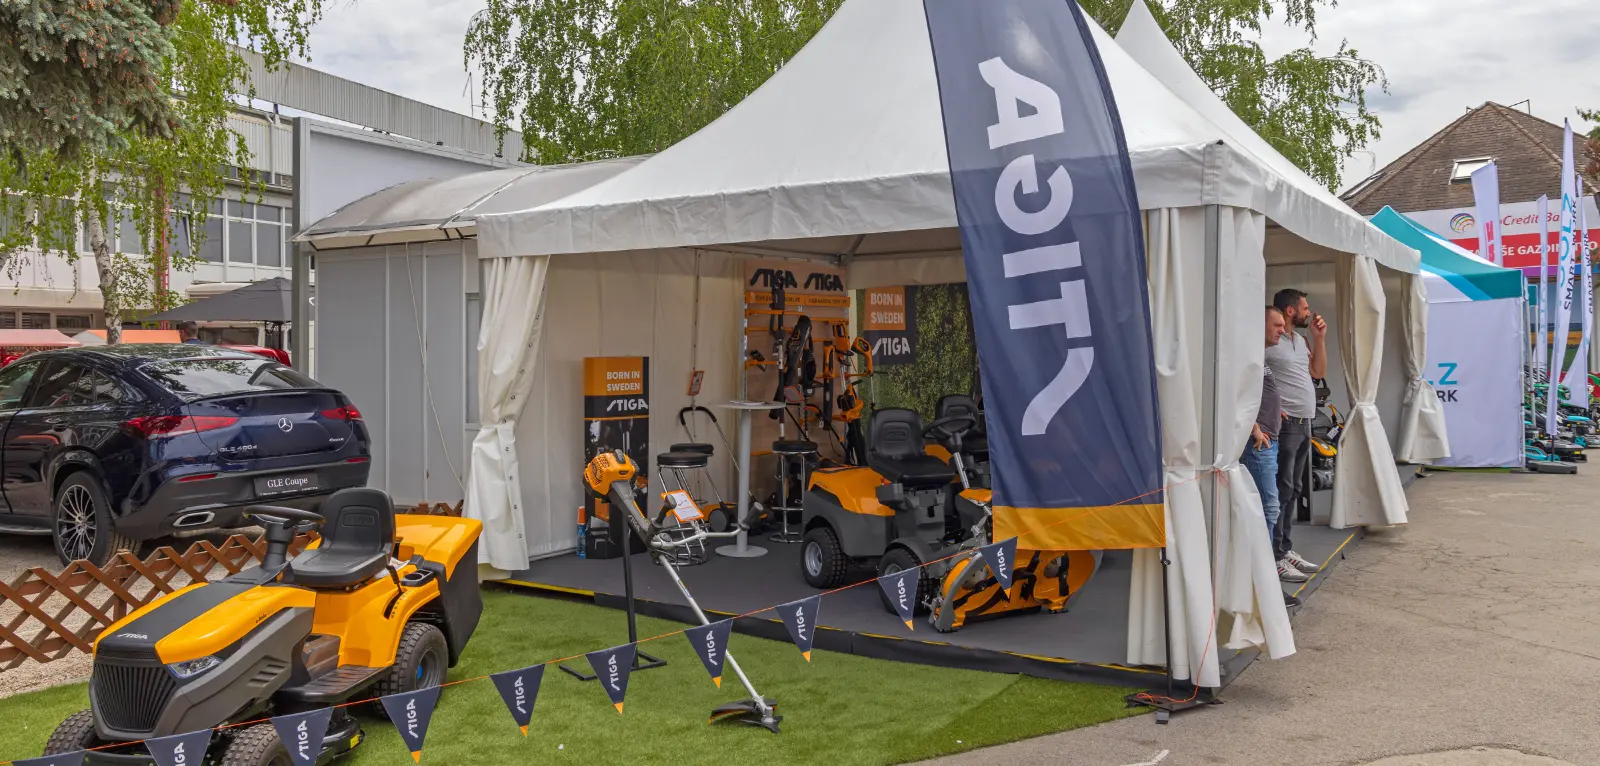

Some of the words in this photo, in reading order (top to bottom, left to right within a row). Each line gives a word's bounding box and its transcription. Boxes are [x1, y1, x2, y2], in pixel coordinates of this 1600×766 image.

[1547, 212, 1560, 222] Ba
[1501, 245, 1515, 256] ŠE
[804, 272, 843, 292] STIGA
[870, 292, 893, 306] BORN
[894, 294, 903, 306] IN
[870, 311, 904, 324] SWEDEN
[872, 337, 911, 356] STIGA
[606, 371, 630, 380] BORN
[631, 371, 640, 379] IN
[606, 383, 640, 391] SWEDEN
[1436, 389, 1458, 403] RK
[606, 398, 649, 412] STIGA
[267, 478, 284, 488] GLE
[284, 477, 308, 487] Coupe
[997, 547, 1008, 579] STIGA
[897, 577, 909, 611] STIGA
[795, 606, 807, 640] STIGA
[706, 630, 718, 666] STIGA
[608, 654, 621, 691] STIGA
[514, 676, 527, 714] STIGA
[406, 699, 419, 739] STIGA
[297, 720, 310, 761] STIGA
